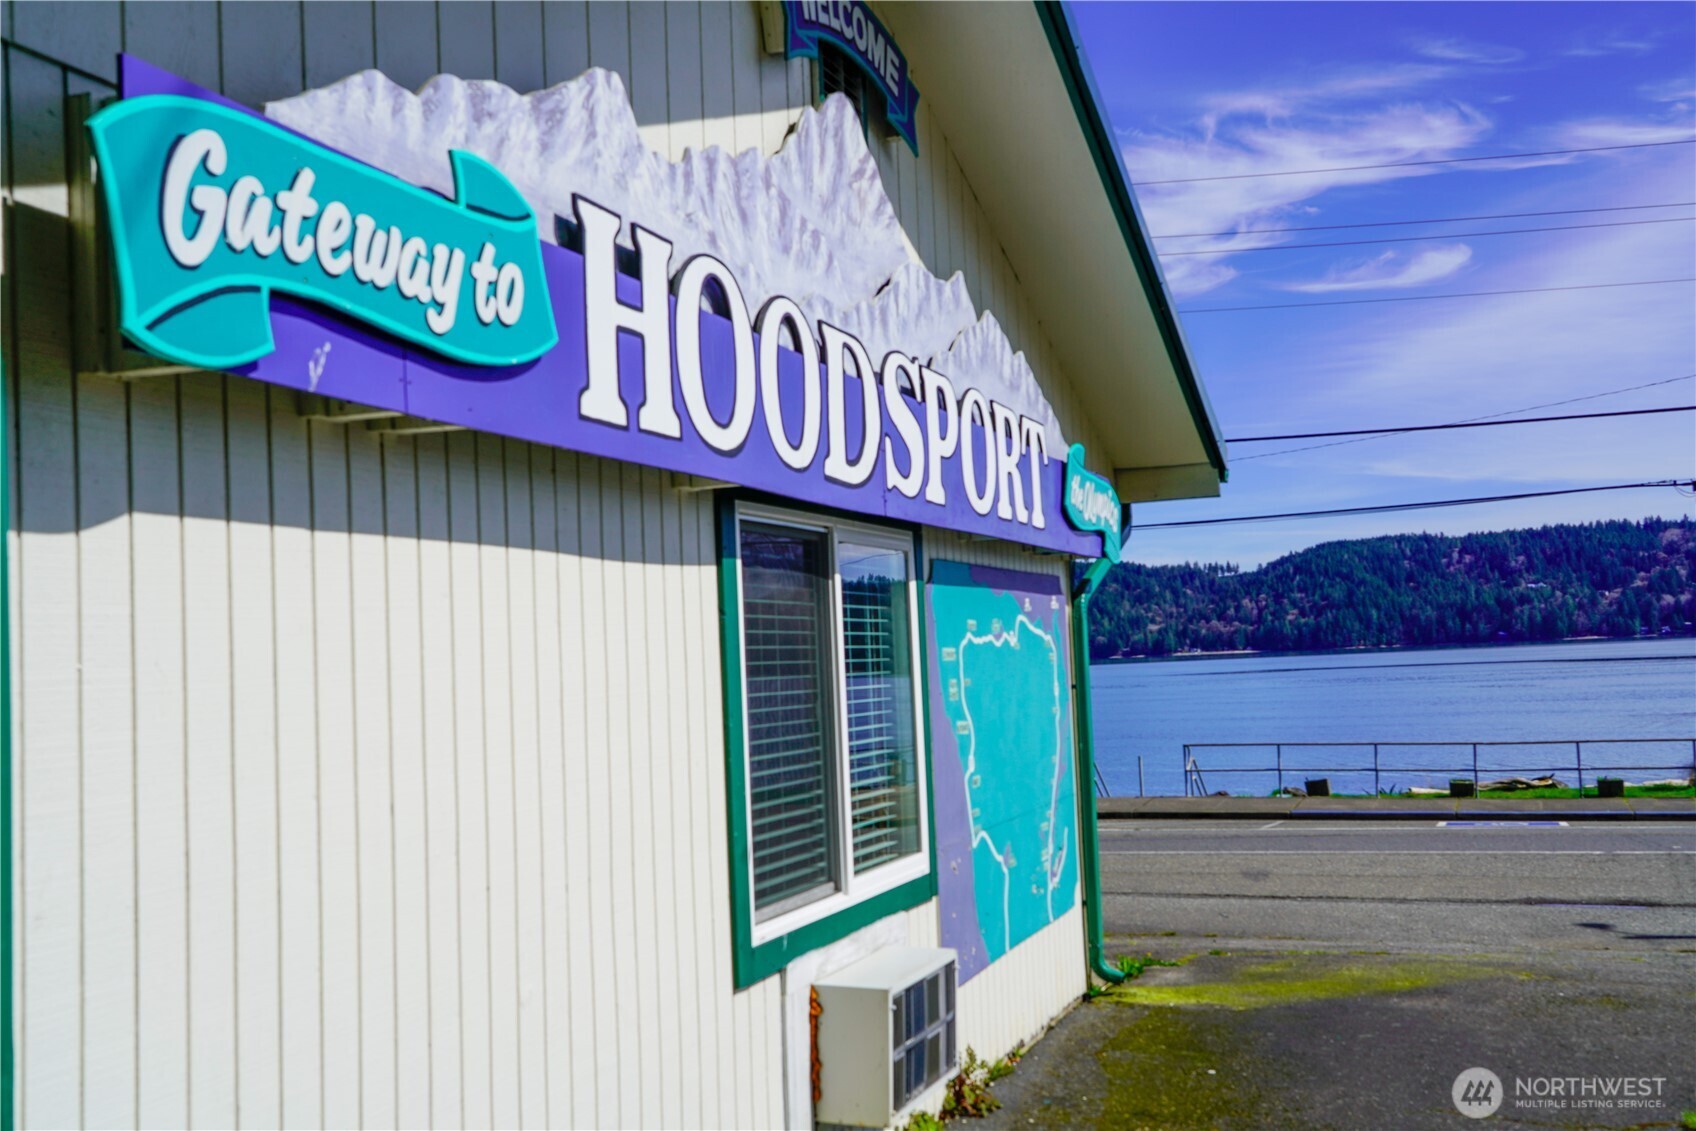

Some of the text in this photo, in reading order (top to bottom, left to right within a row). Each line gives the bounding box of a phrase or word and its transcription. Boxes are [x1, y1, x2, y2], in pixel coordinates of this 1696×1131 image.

[163, 129, 525, 335] Gateway to
[572, 193, 1049, 529] HOODSPORT
